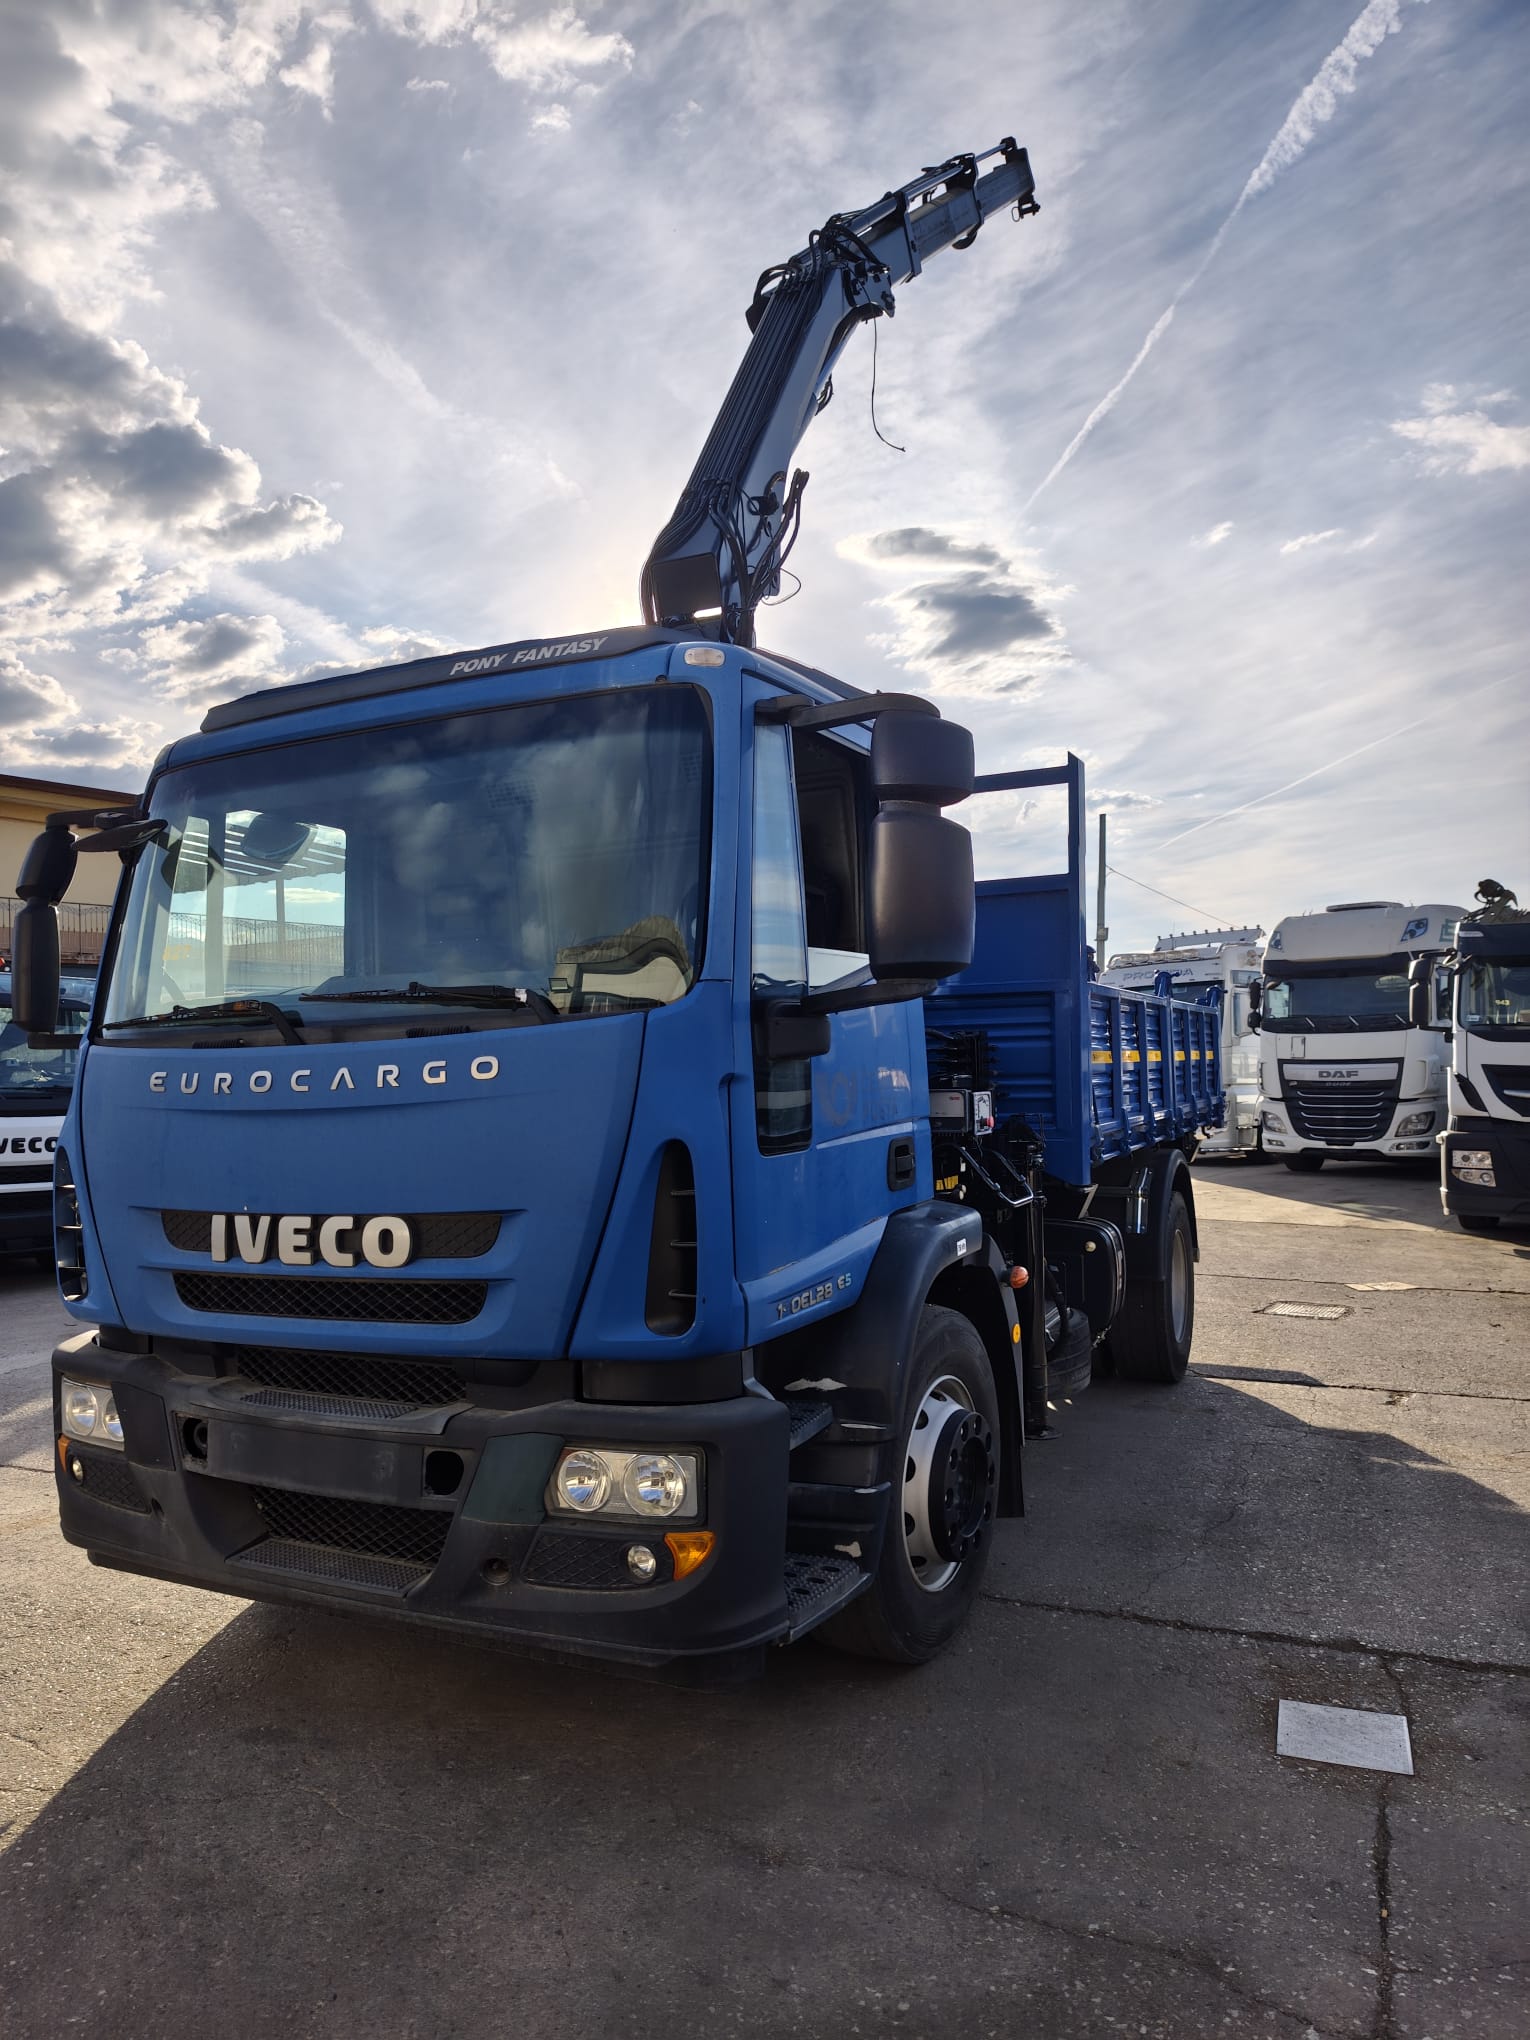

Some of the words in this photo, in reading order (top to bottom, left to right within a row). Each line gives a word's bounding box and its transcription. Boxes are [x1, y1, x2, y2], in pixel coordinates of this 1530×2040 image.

[449, 653, 507, 676] PONY
[512, 637, 608, 664] FANTASY
[149, 1056, 500, 1094] EUROCARGO
[1318, 1070, 1359, 1079] DAF
[211, 1213, 412, 1268] IVECO
